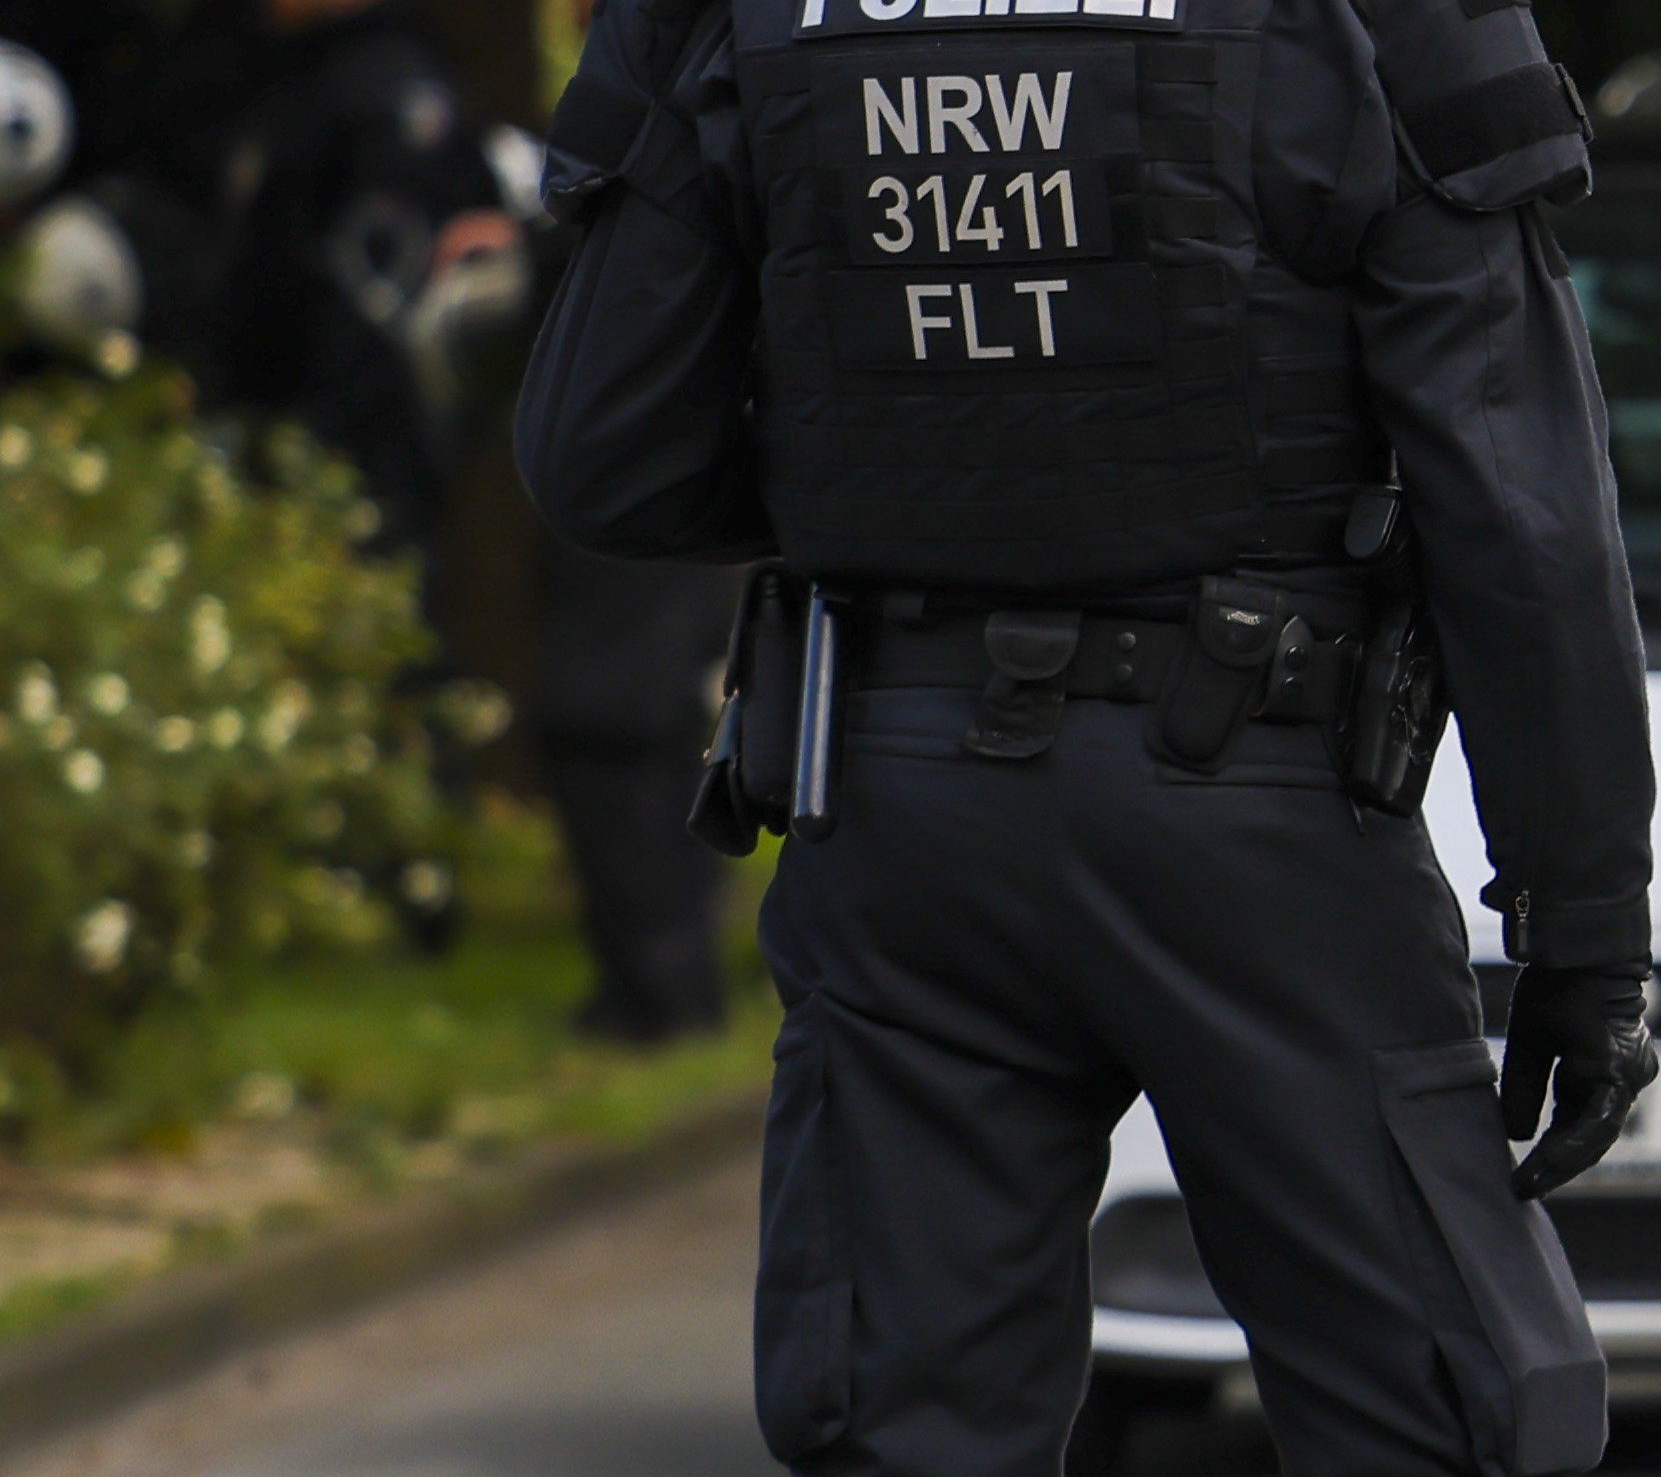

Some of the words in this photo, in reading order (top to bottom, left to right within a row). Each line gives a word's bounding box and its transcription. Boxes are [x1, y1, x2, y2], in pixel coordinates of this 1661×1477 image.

[864, 72, 1072, 155] NRW
[869, 170, 1077, 252] 31411
[906, 280, 1067, 359] FLT
